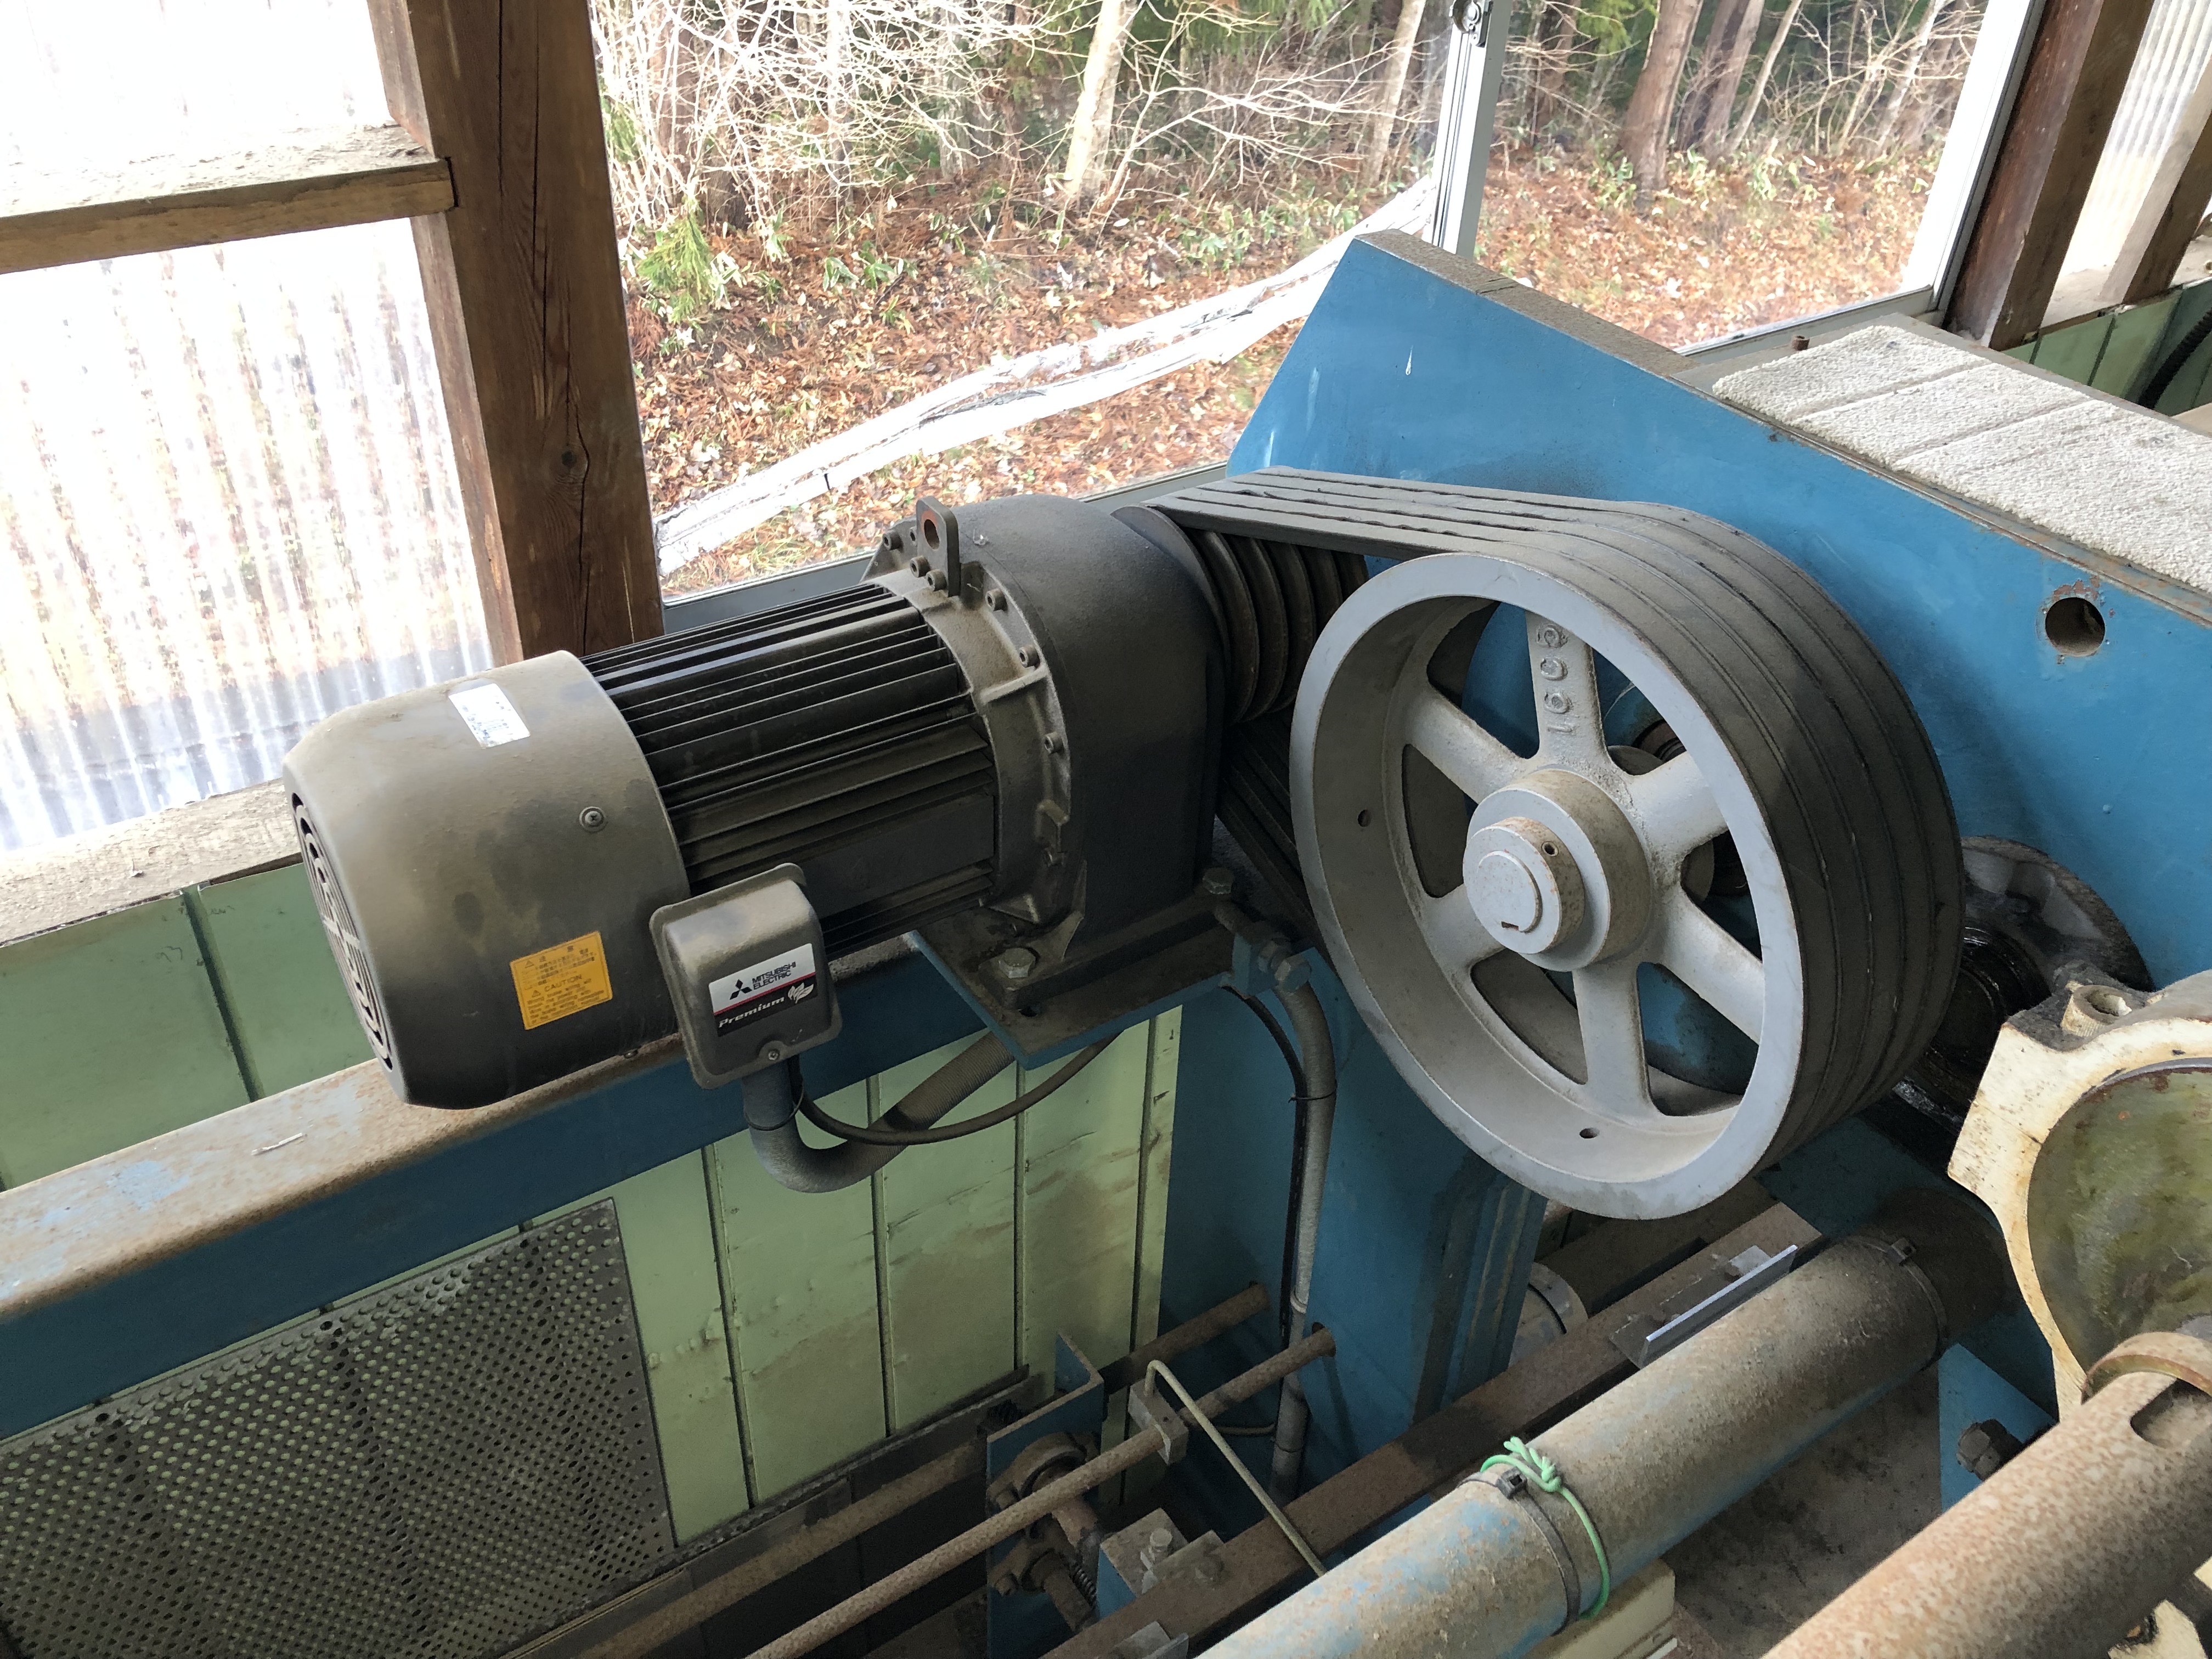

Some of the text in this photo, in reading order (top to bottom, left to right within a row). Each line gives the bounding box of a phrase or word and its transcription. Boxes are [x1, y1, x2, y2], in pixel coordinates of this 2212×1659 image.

[544, 974, 582, 992] CAUTION
[752, 961, 796, 984] MITSUBISHI
[753, 970, 792, 990] ELECTRIC
[719, 996, 785, 1028] Premium
